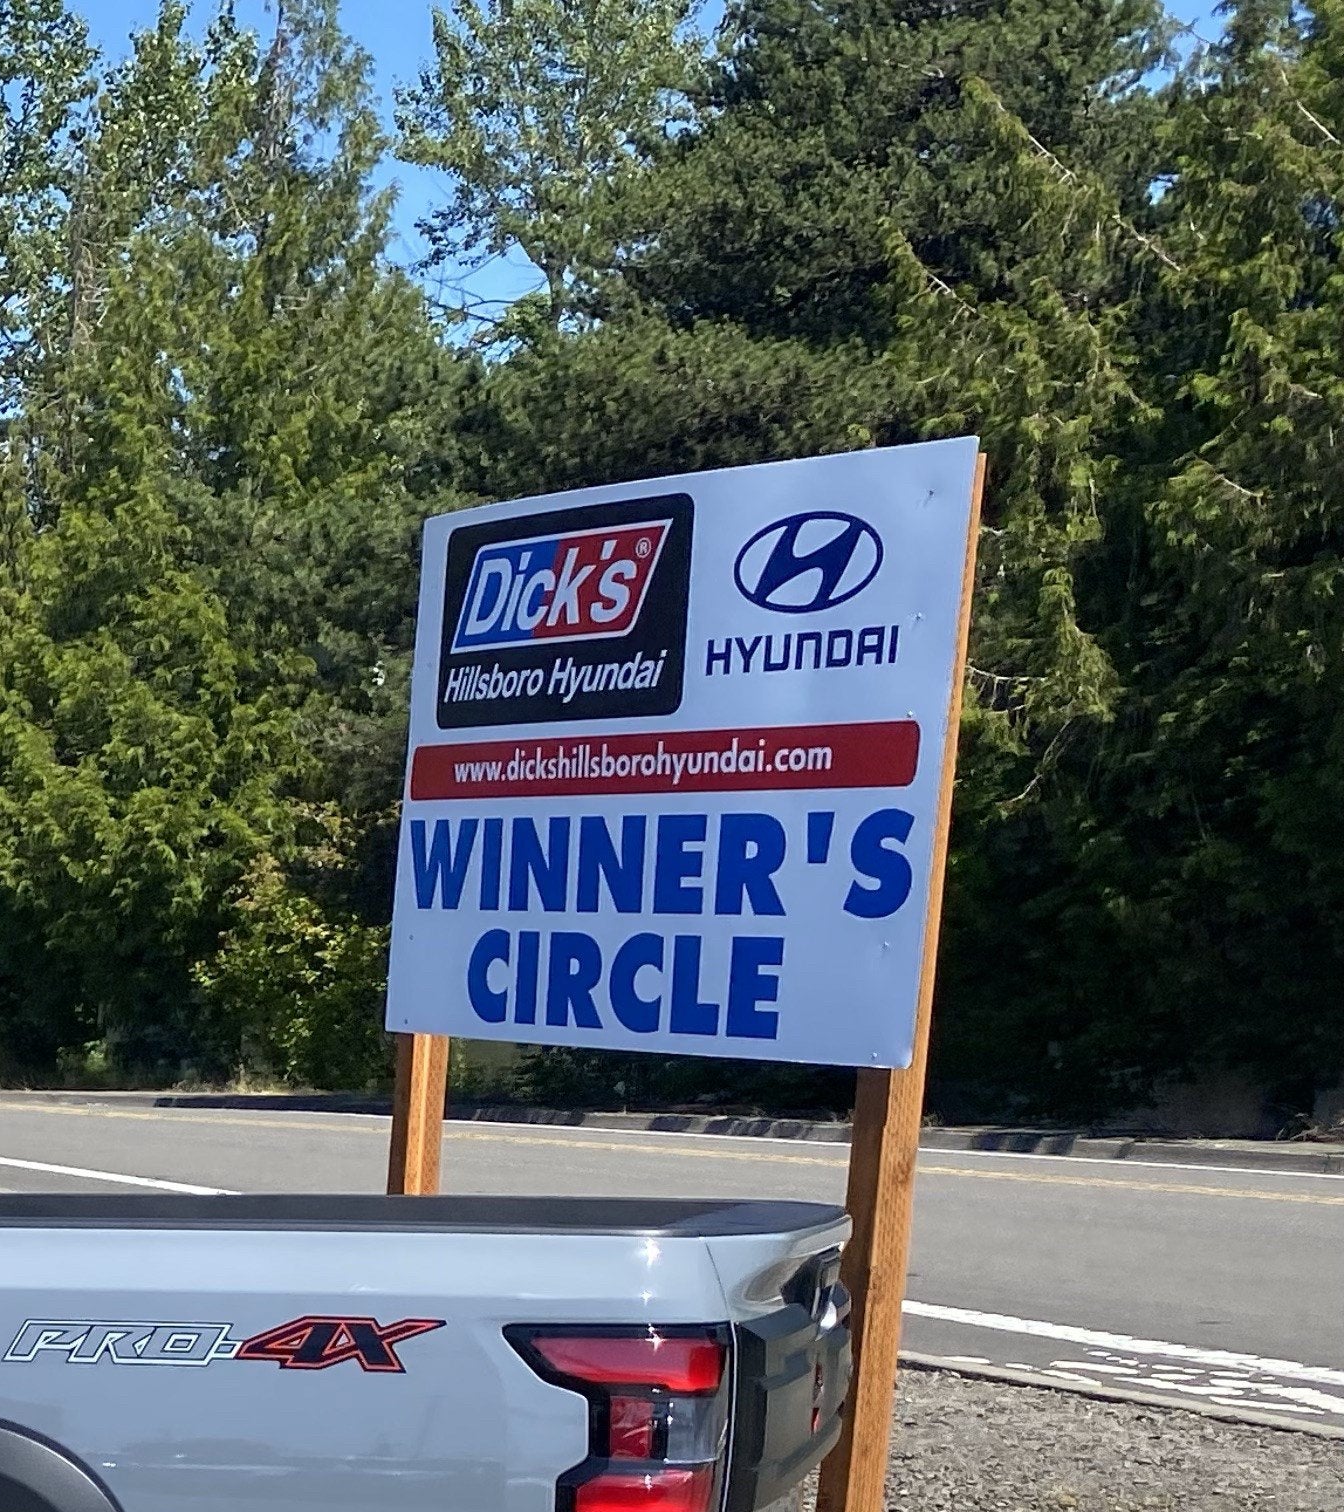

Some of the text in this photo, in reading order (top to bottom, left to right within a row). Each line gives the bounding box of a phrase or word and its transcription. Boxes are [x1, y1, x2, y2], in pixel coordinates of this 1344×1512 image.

[443, 650, 669, 704] Hillsboro Hyundai
[705, 624, 900, 676] HYUNDAI
[453, 738, 833, 785] www.dickshillsborohyundai.com
[410, 808, 916, 919] WINNER'S
[467, 928, 786, 1041] CIRCLE
